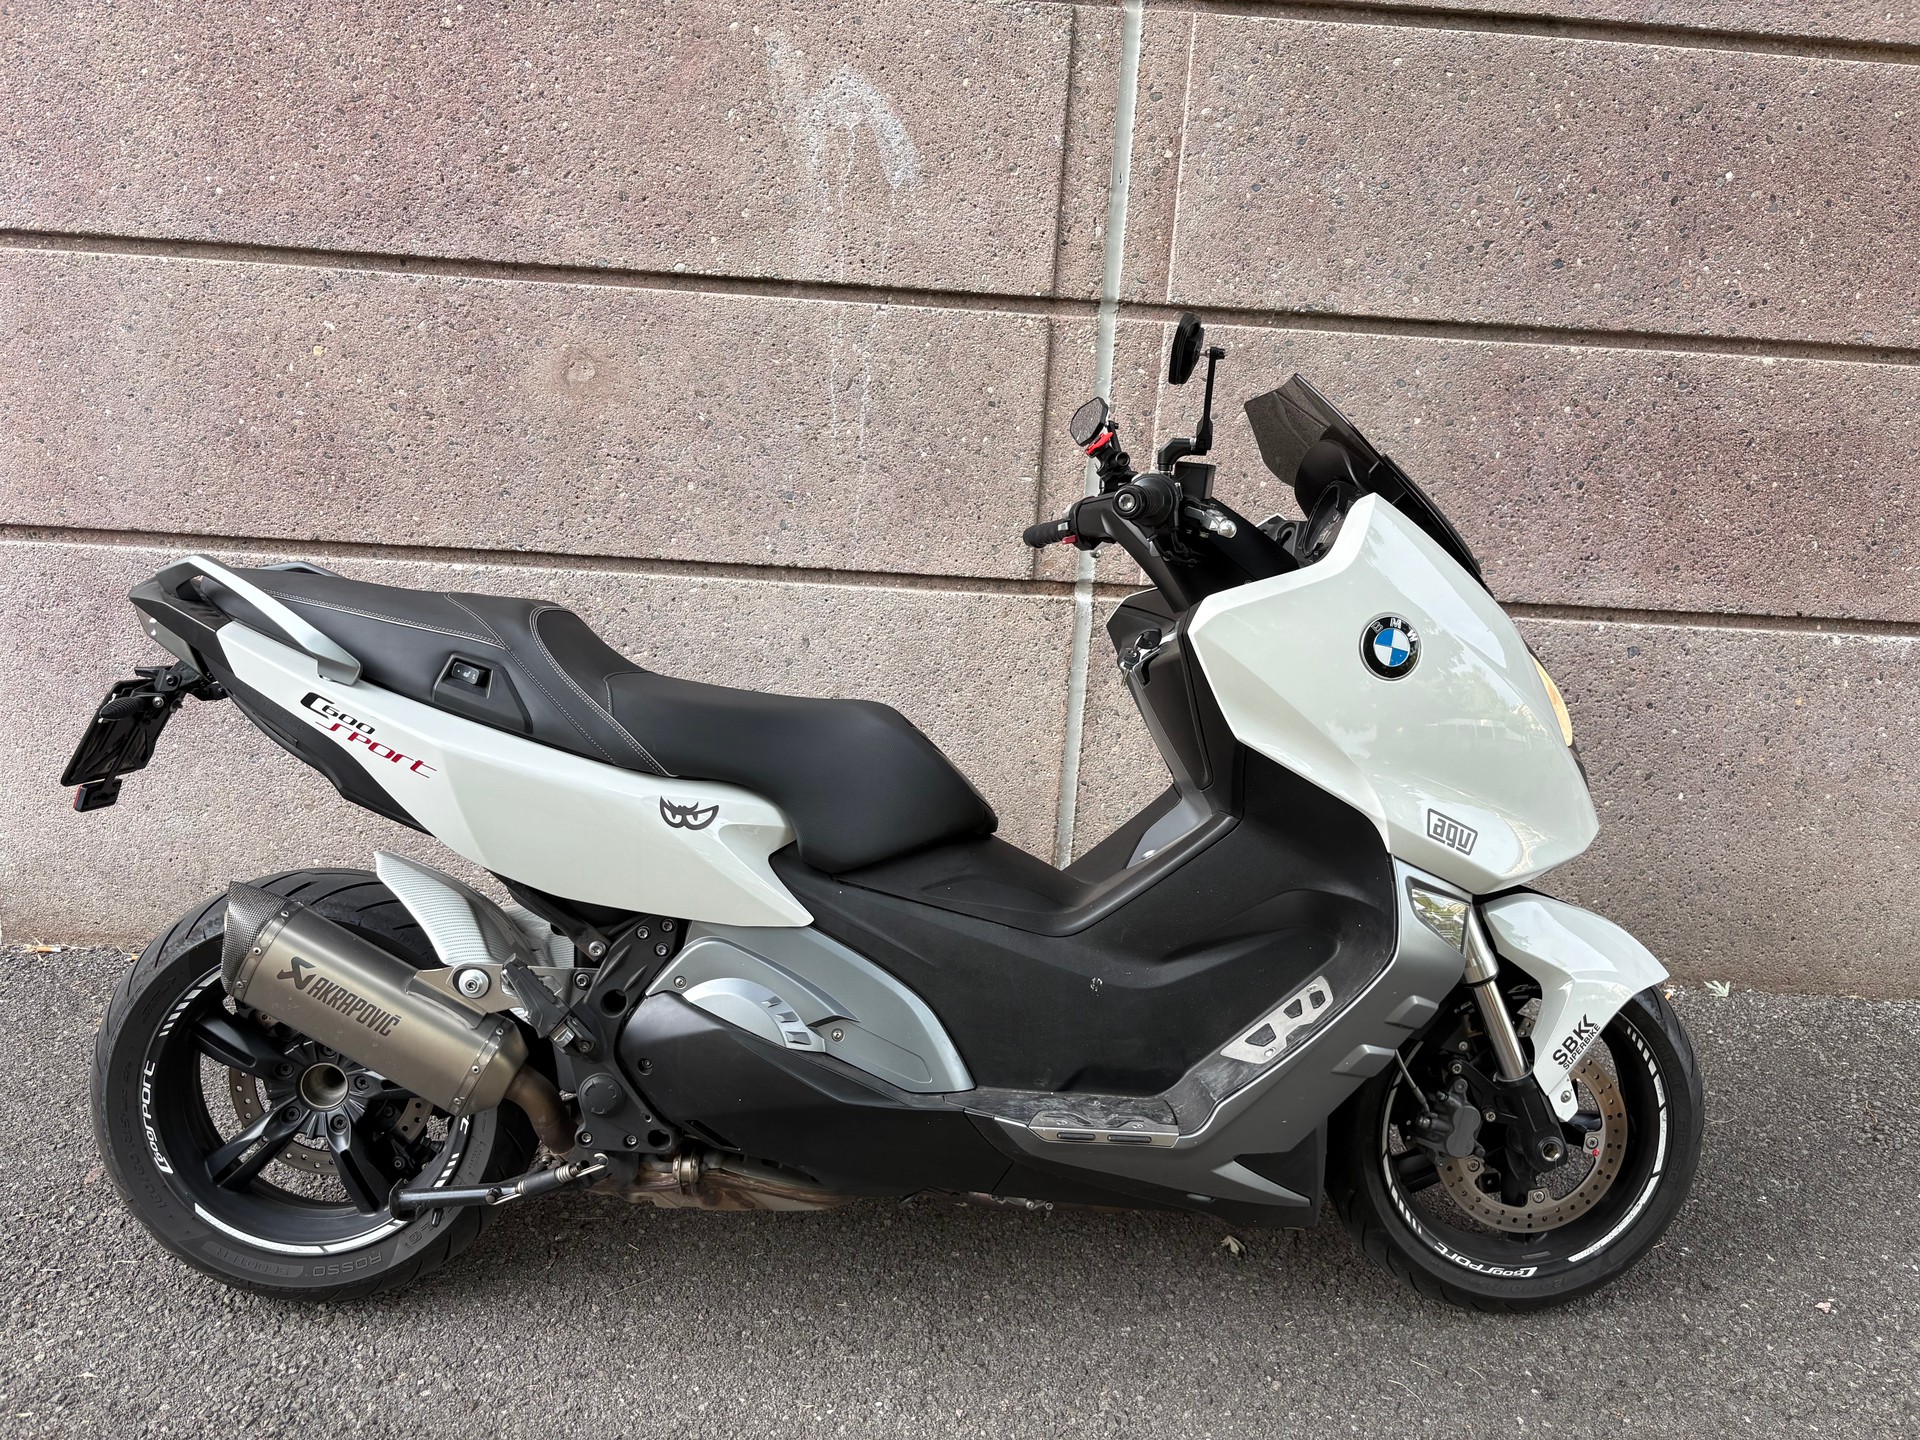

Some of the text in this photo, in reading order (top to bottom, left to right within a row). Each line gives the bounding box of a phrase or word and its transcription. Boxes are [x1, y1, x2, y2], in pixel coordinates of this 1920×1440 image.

[1371, 617, 1418, 644] BMW
[300, 692, 376, 735] C600
[1552, 1014, 1595, 1066] SBK
[1562, 1023, 1601, 1070] SUPERBIKE
[312, 1251, 382, 1278] ROSSO
